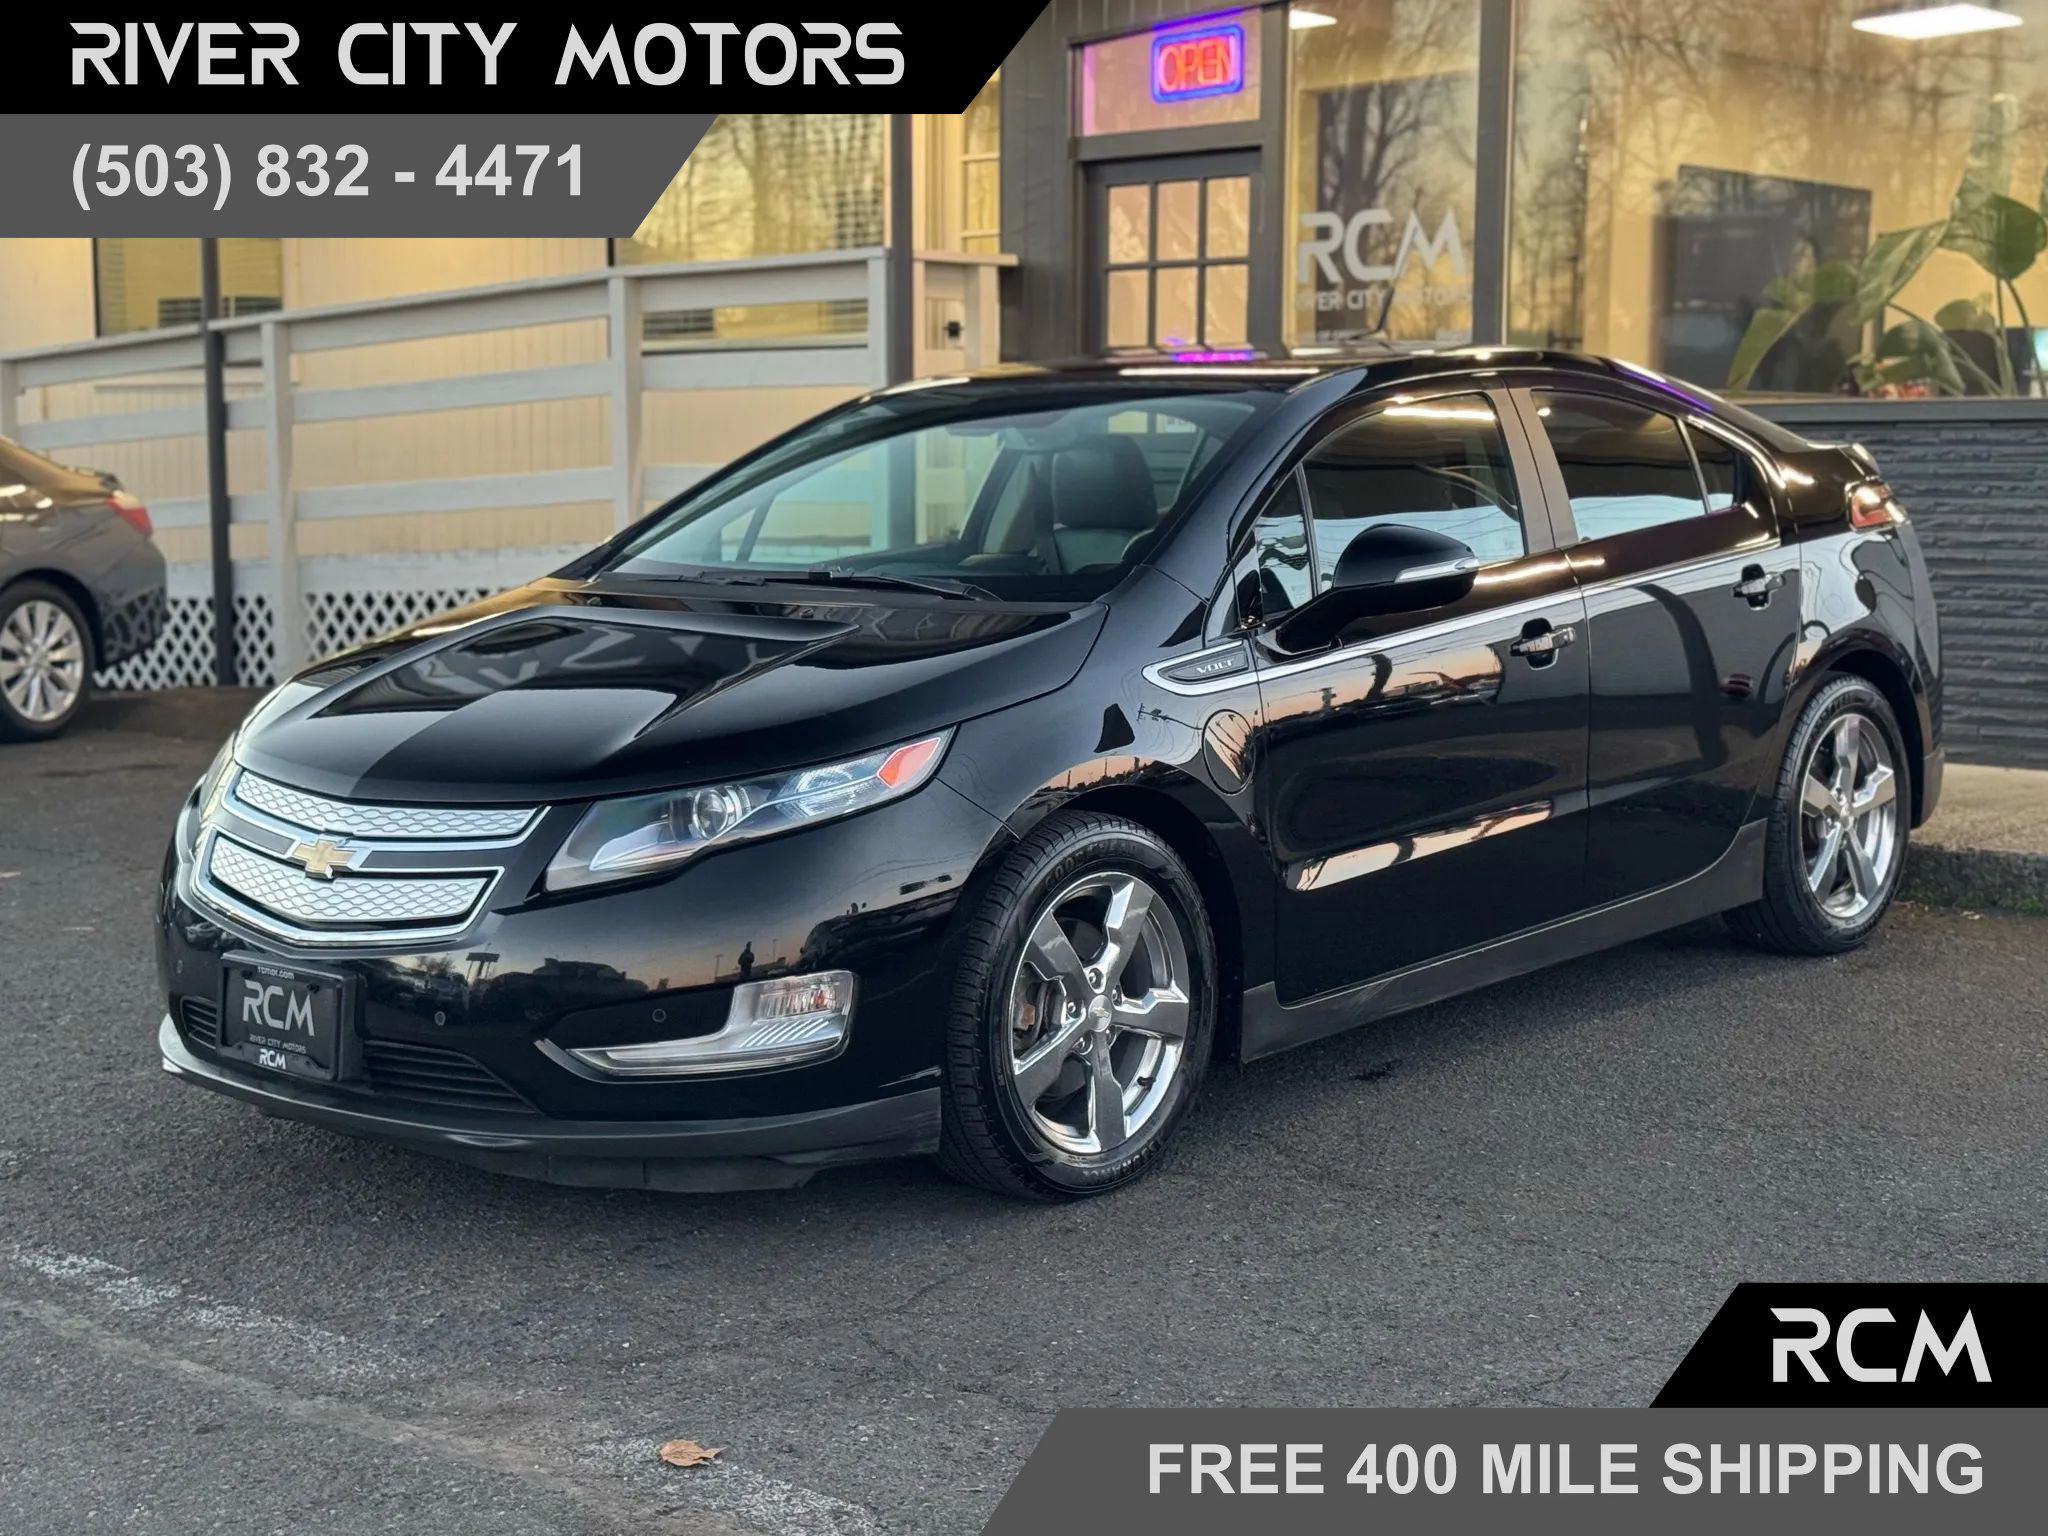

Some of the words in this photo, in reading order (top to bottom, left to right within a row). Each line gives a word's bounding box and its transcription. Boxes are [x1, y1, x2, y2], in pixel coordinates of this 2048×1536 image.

[1159, 35, 1236, 93] OPEN
[1296, 207, 1468, 284] RCM
[1195, 658, 1235, 674] VOLT
[242, 979, 315, 1037] RCM
[259, 1047, 287, 1070] RCM
[267, 1038, 281, 1048] CITY
